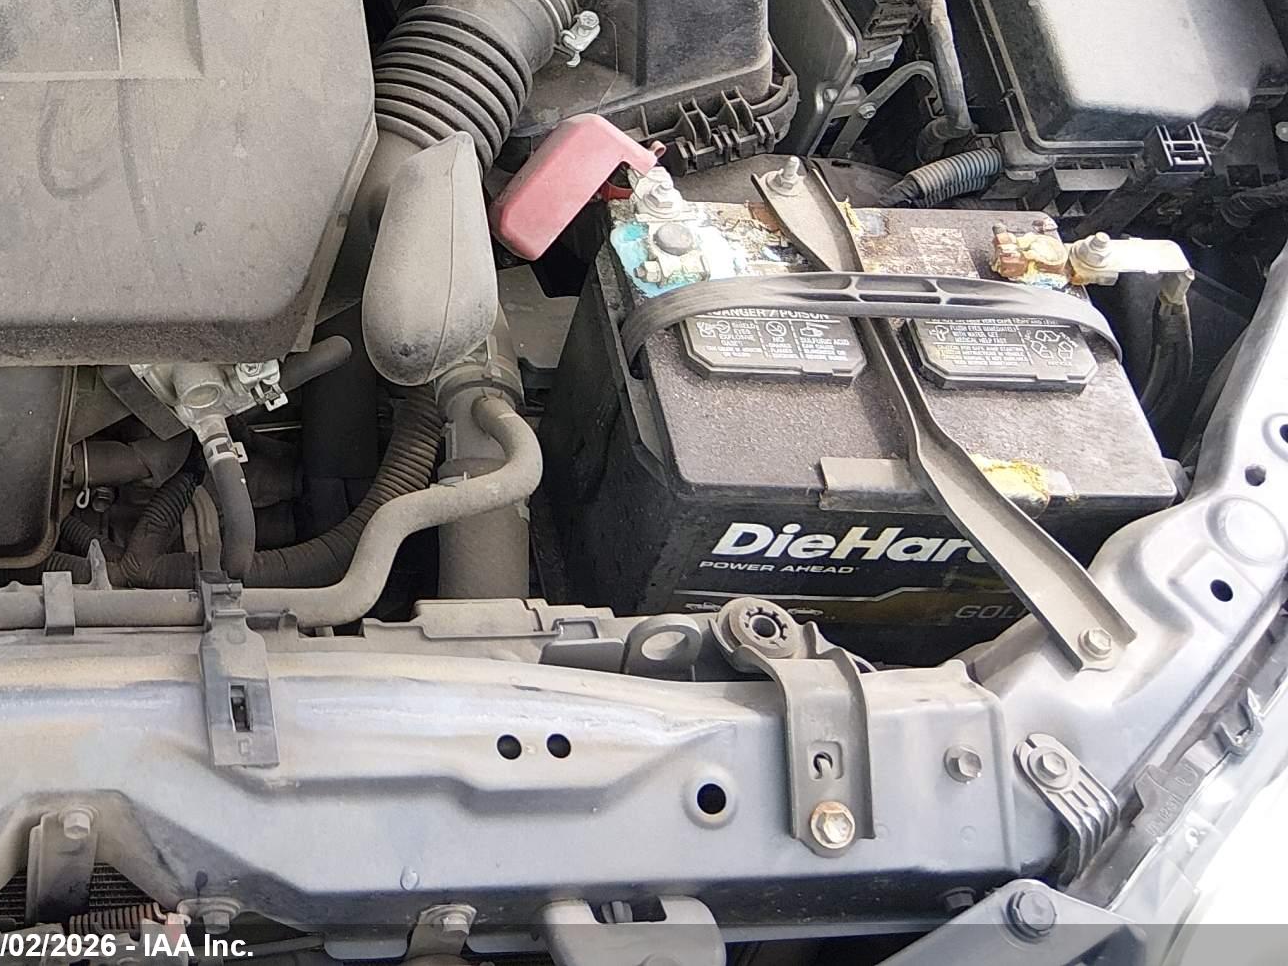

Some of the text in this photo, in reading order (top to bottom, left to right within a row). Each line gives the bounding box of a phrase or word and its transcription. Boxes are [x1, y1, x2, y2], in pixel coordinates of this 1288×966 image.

[699, 560, 856, 574] POWER AHEAD
[955, 604, 1026, 619] GOL
